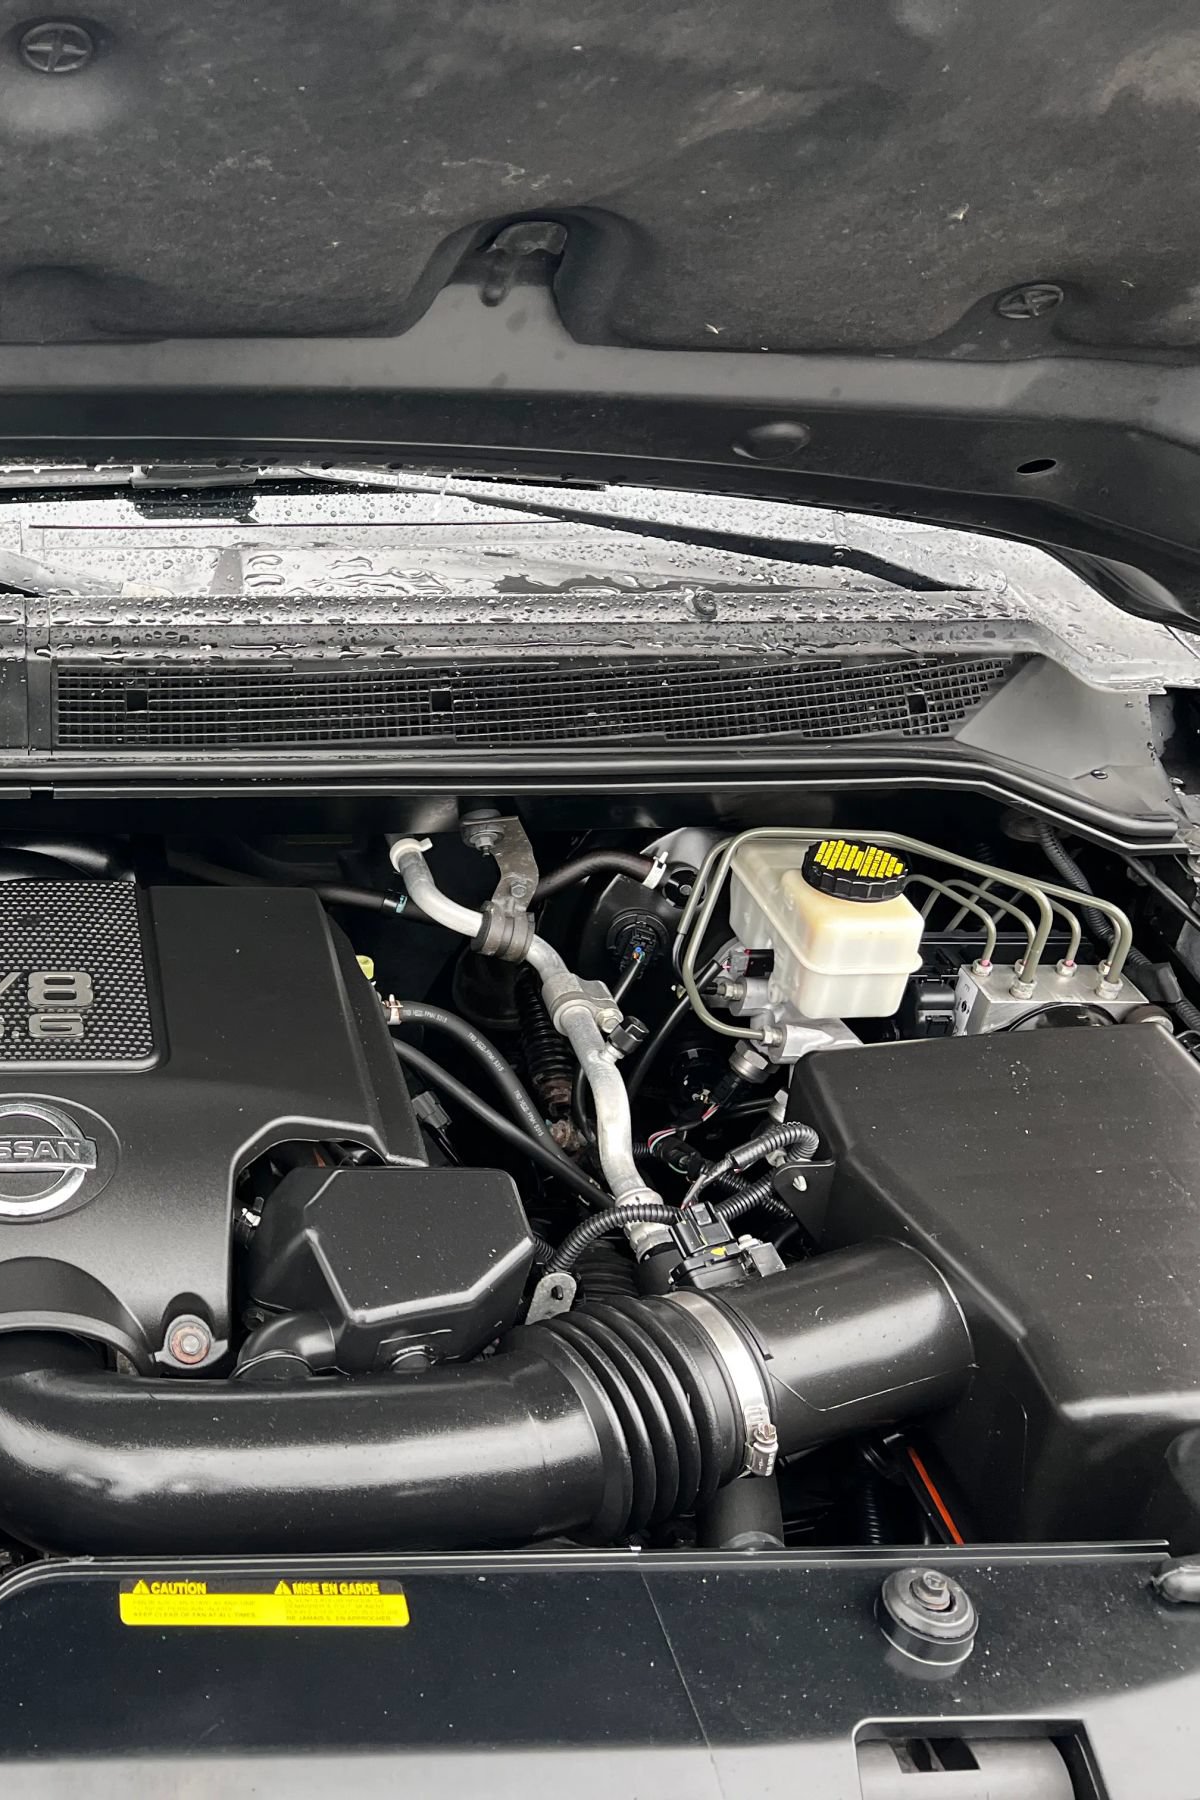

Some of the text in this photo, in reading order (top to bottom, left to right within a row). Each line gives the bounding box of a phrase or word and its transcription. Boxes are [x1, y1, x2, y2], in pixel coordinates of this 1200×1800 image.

[150, 1581, 207, 1595] CAUTION
[292, 1582, 380, 1595] MISE EN GARDE
